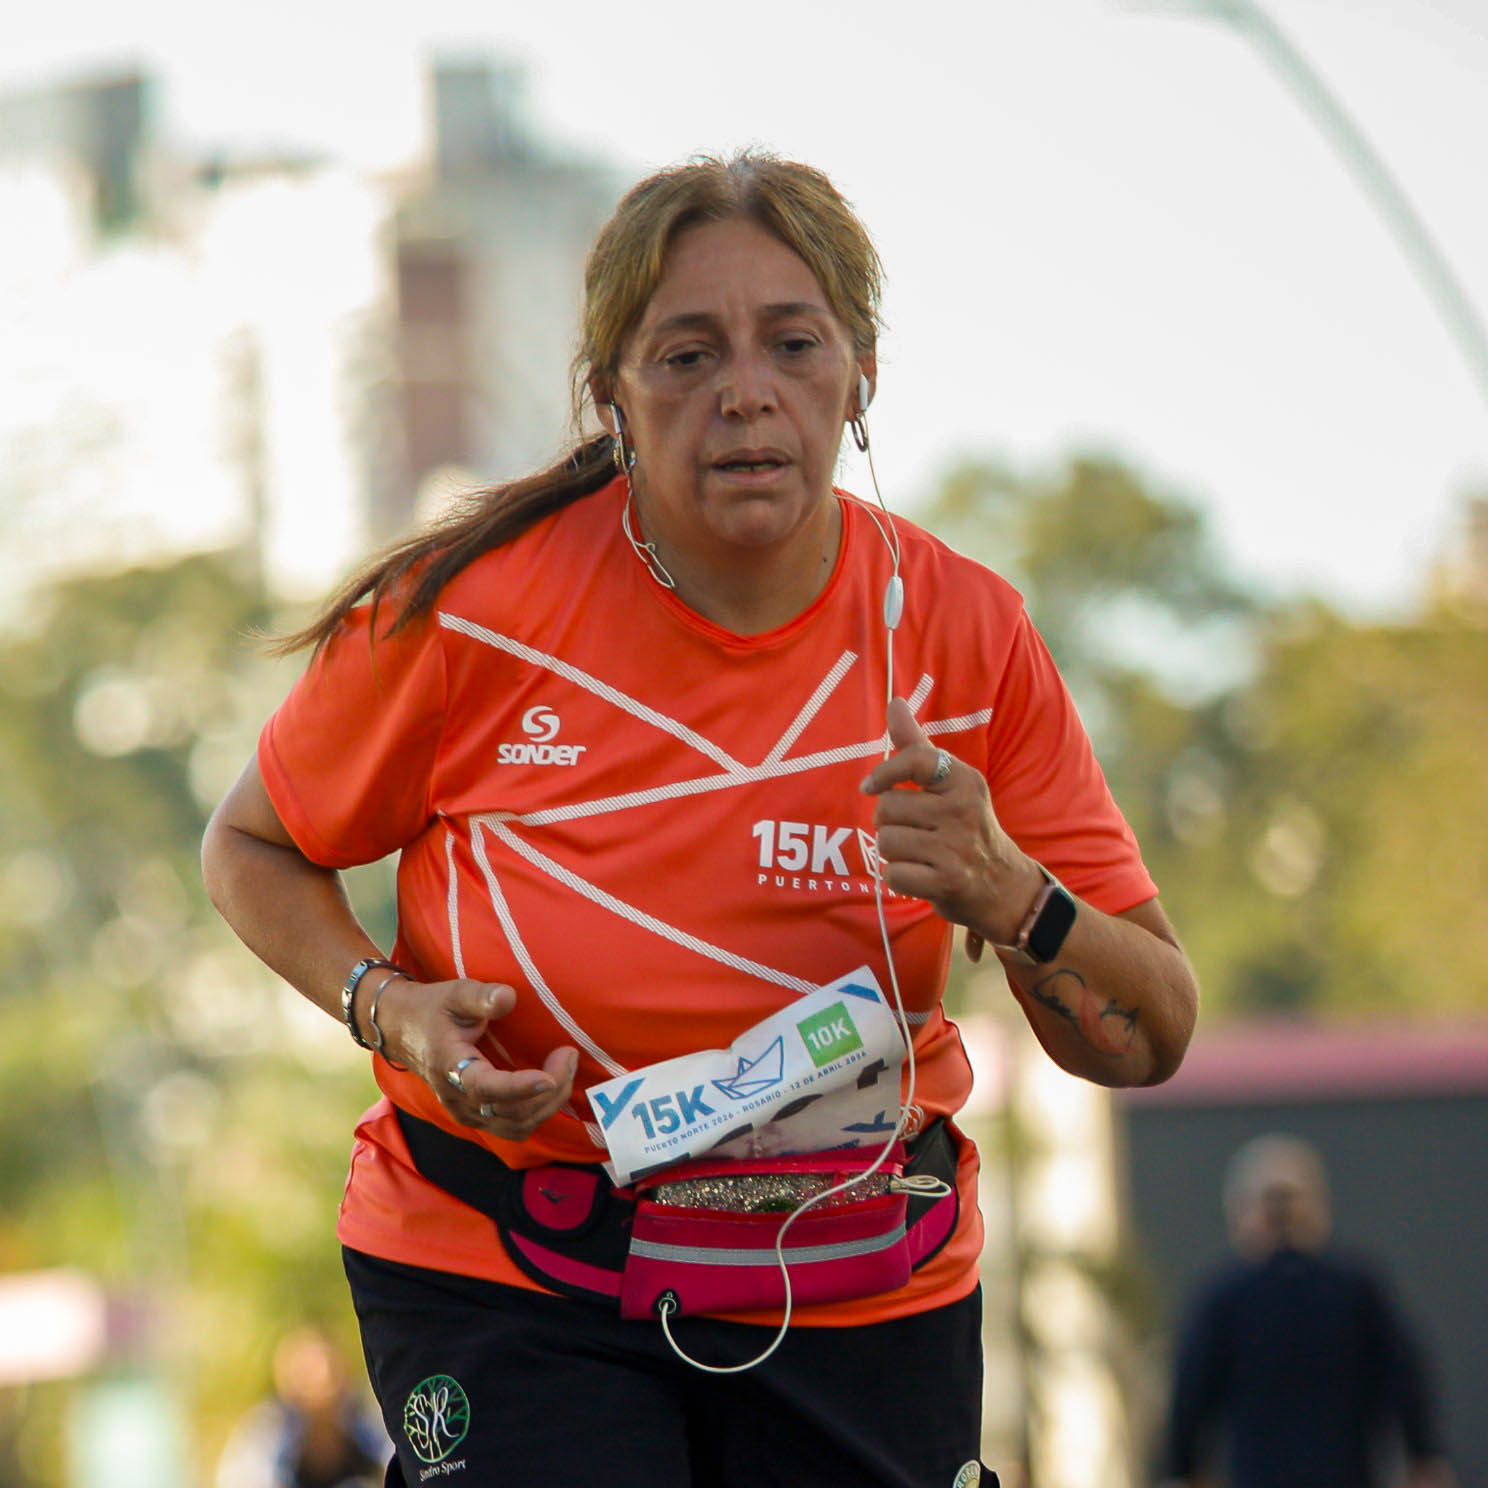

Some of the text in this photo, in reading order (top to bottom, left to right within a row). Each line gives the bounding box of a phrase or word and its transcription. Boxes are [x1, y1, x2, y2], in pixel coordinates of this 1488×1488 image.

[752, 819, 853, 877] 15K
[758, 873, 851, 892] PUERTO
[808, 1018, 852, 1051] 10K
[631, 1084, 716, 1140] 15K
